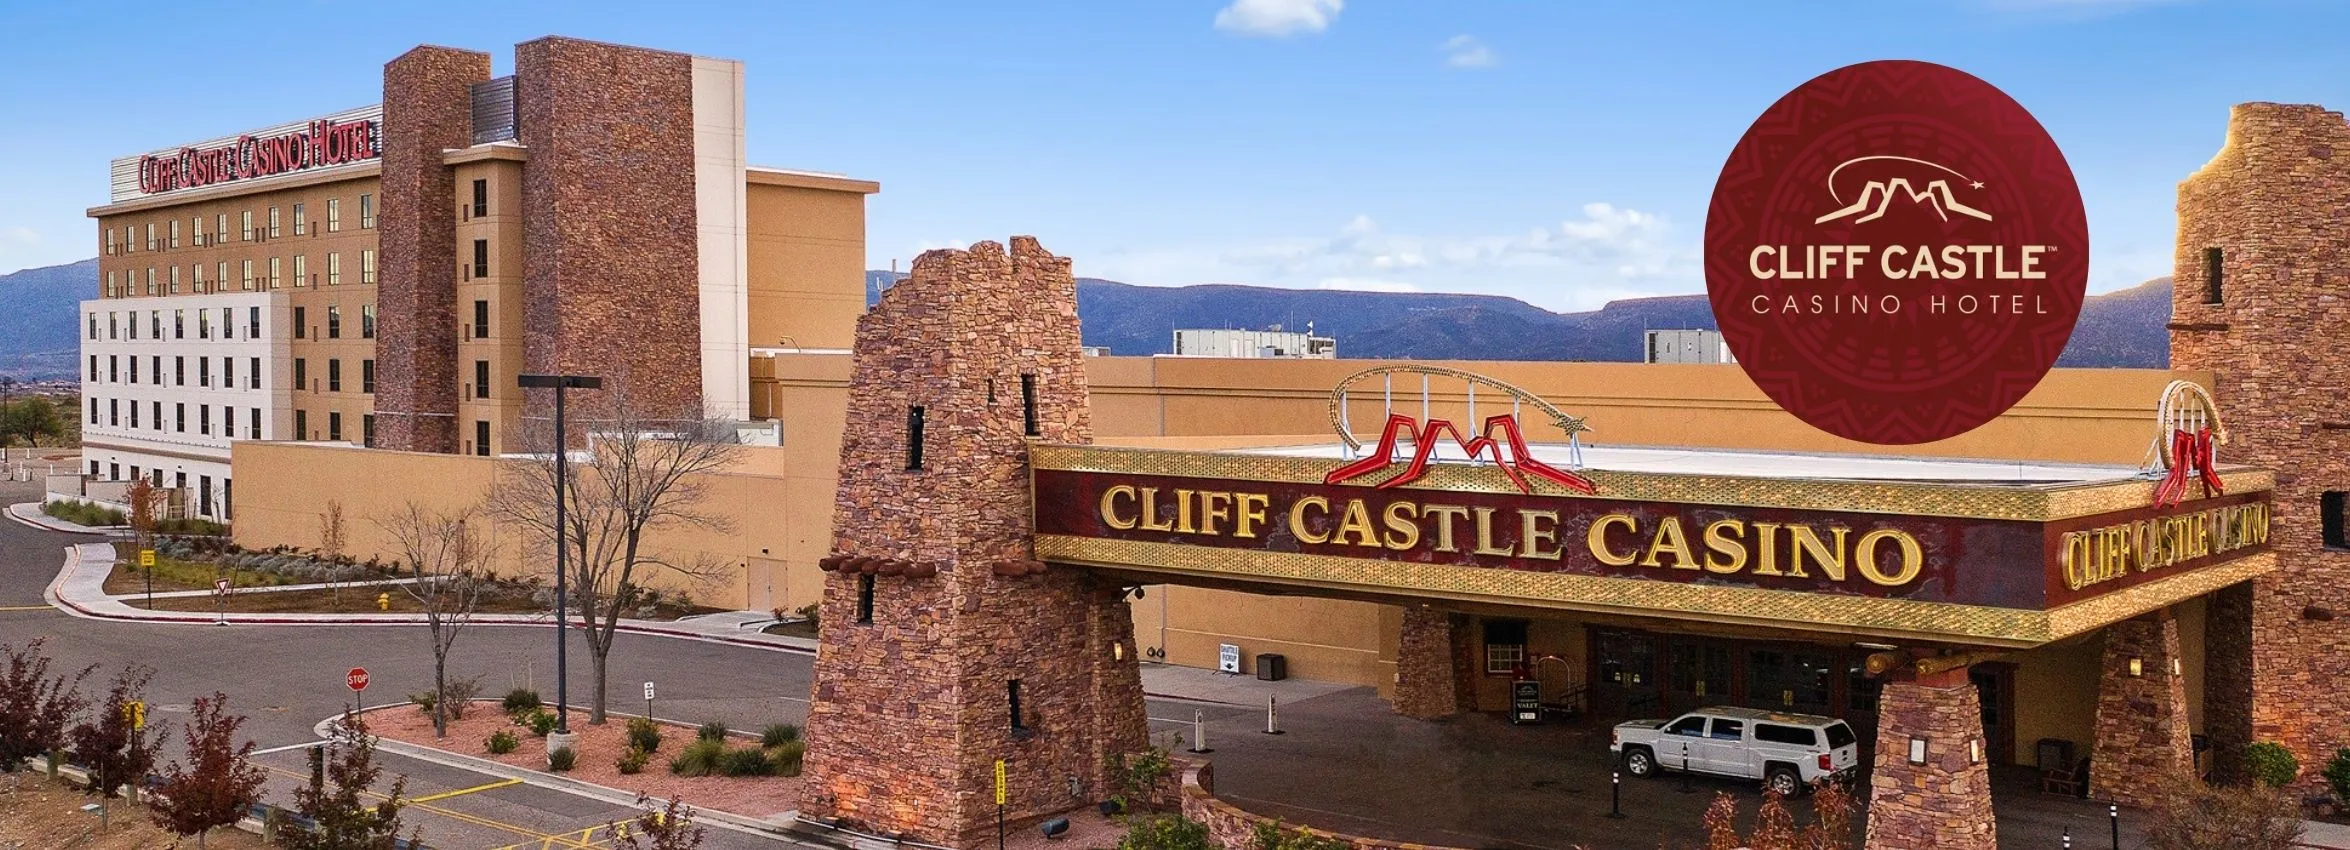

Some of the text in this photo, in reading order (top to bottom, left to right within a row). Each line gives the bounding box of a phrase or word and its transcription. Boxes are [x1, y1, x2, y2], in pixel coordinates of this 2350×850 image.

[138, 119, 373, 193] CLIFF CASTLE CASINO HOTEL
[1100, 485, 1923, 587] CLIFF CASTLE CASINO
[2061, 502, 2269, 591] CLIFF CASTLE CASINO
[348, 673, 368, 685] STOP
